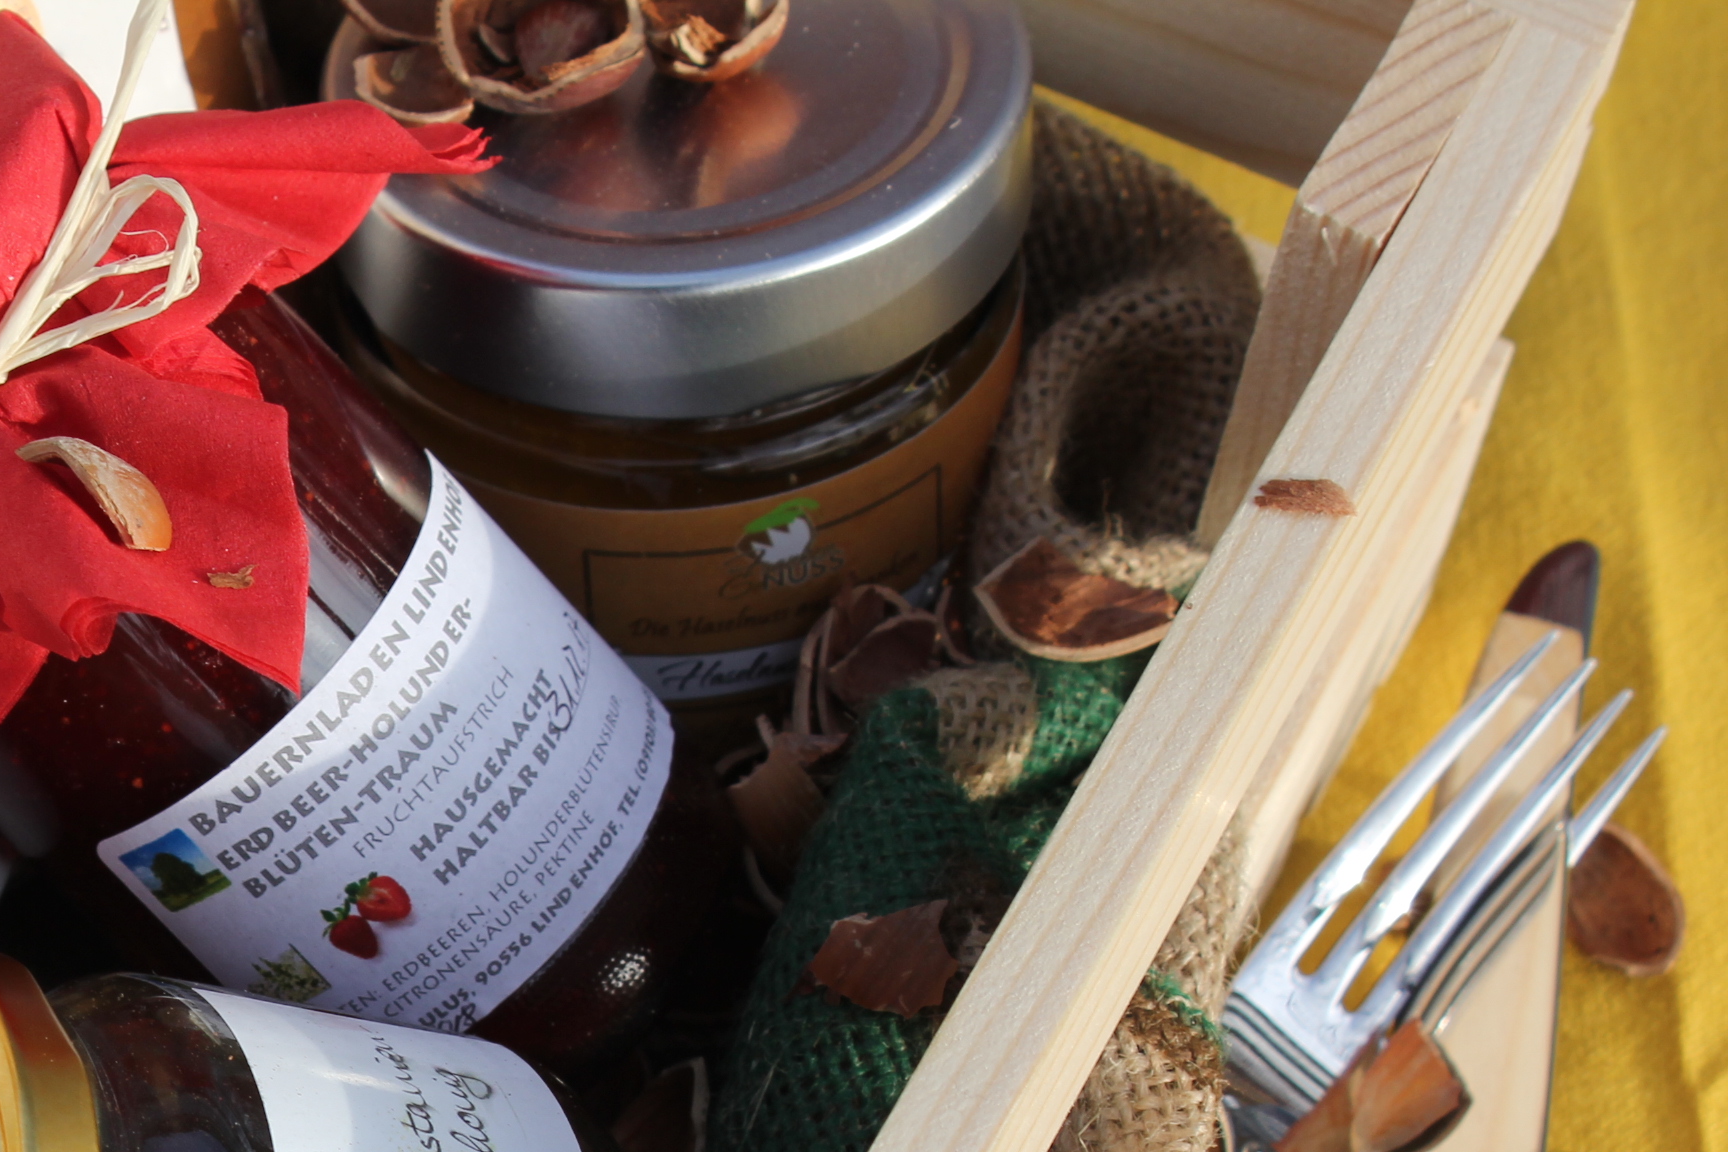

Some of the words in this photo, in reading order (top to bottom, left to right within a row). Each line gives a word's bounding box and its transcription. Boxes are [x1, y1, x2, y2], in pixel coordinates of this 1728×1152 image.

[189, 618, 412, 837] BAUERNLADEN
[217, 597, 473, 871] ERDBEER-HOLUNDER-
[242, 701, 459, 899] BLÜTEN-TRAUM
[352, 664, 515, 859] FRUCHTAUFSTRICH
[409, 668, 552, 862] HAUSGEMACHT
[432, 765, 539, 886] HALTBAR
[475, 931, 533, 985] 90556
[617, 784, 641, 817] TEL.
[536, 808, 595, 888] PEKTINE
